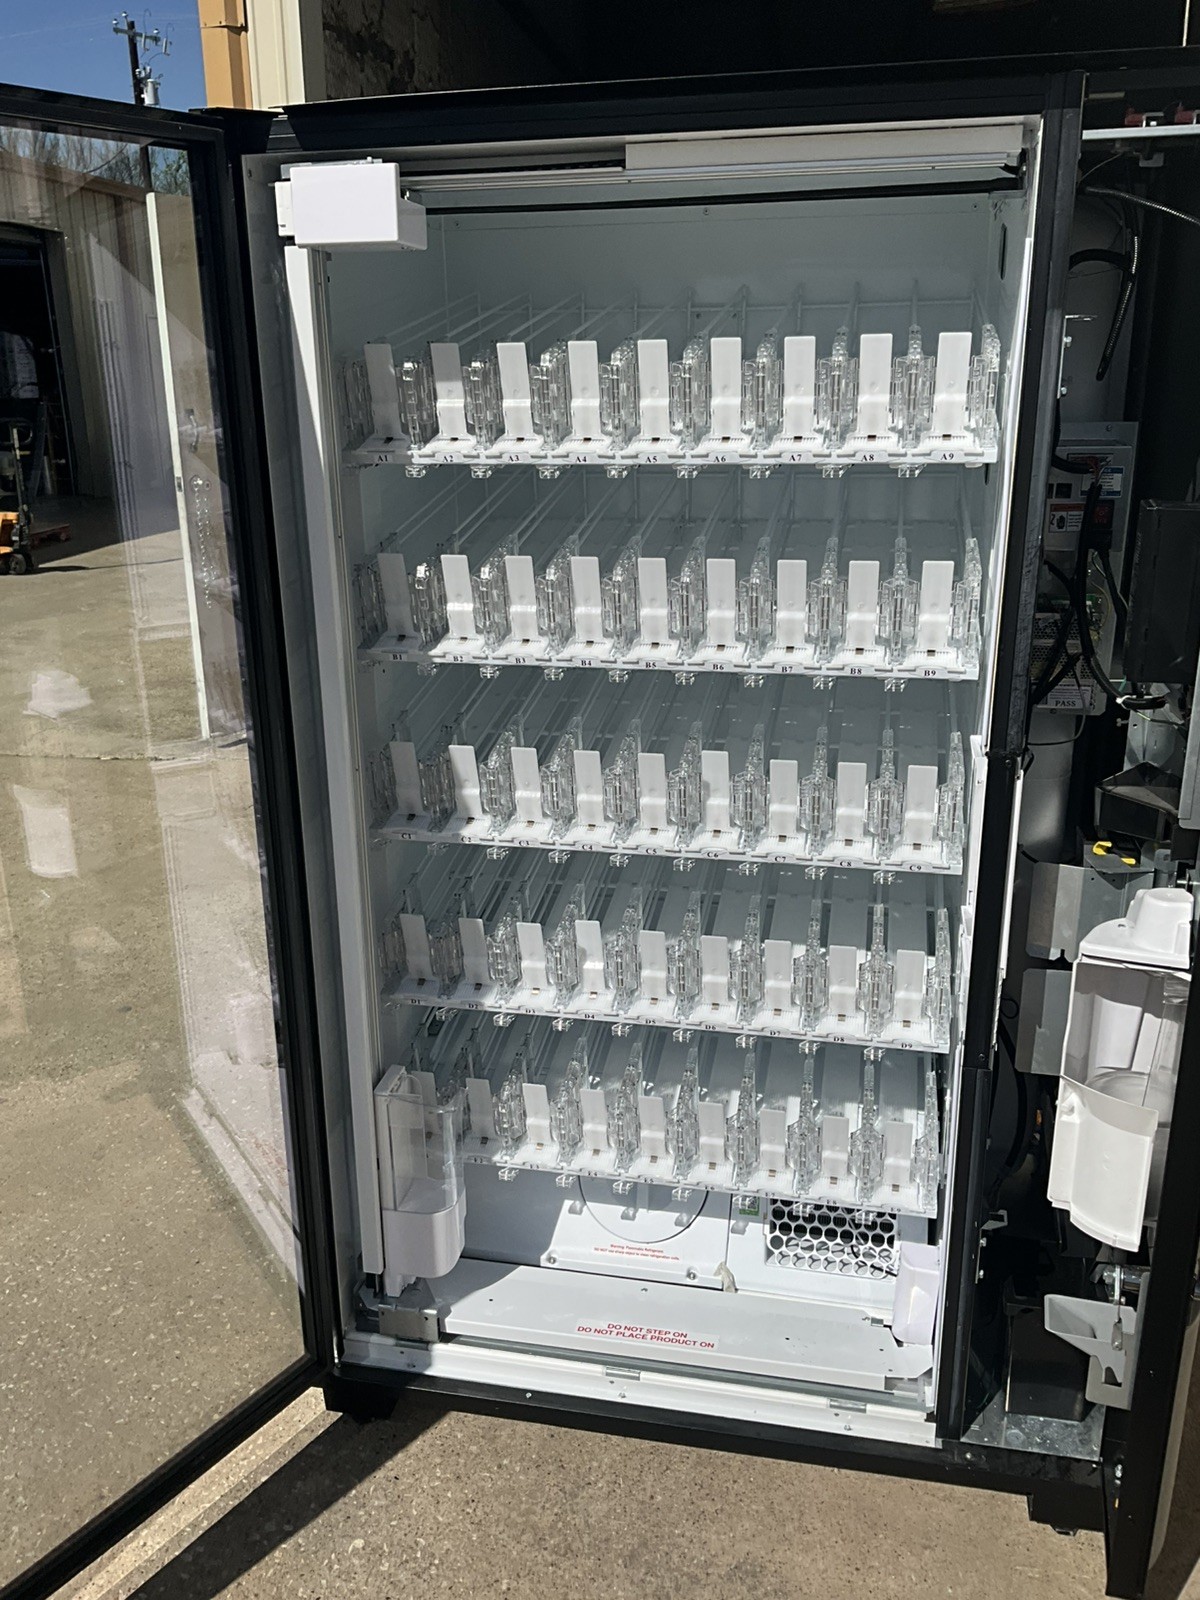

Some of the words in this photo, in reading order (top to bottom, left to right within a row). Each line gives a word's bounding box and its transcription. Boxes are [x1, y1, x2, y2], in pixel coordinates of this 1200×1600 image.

[442, 455, 454, 463] A2
[507, 454, 520, 462] A3
[575, 455, 587, 463] A4
[645, 455, 658, 463] A5
[714, 454, 726, 463] A6
[789, 454, 802, 462] A7
[861, 454, 874, 462] A8
[941, 452, 954, 461] A9
[645, 661, 657, 669] B5
[712, 663, 724, 671] B6
[924, 669, 937, 677] B9
[623, 1325, 644, 1333] NOT
[646, 1328, 671, 1336] STEP
[672, 1331, 688, 1339] ON
[593, 1328, 614, 1336] NOT
[616, 1330, 648, 1340] PLACE
[650, 1335, 698, 1346] PRODUCT
[699, 1341, 715, 1349] ON
